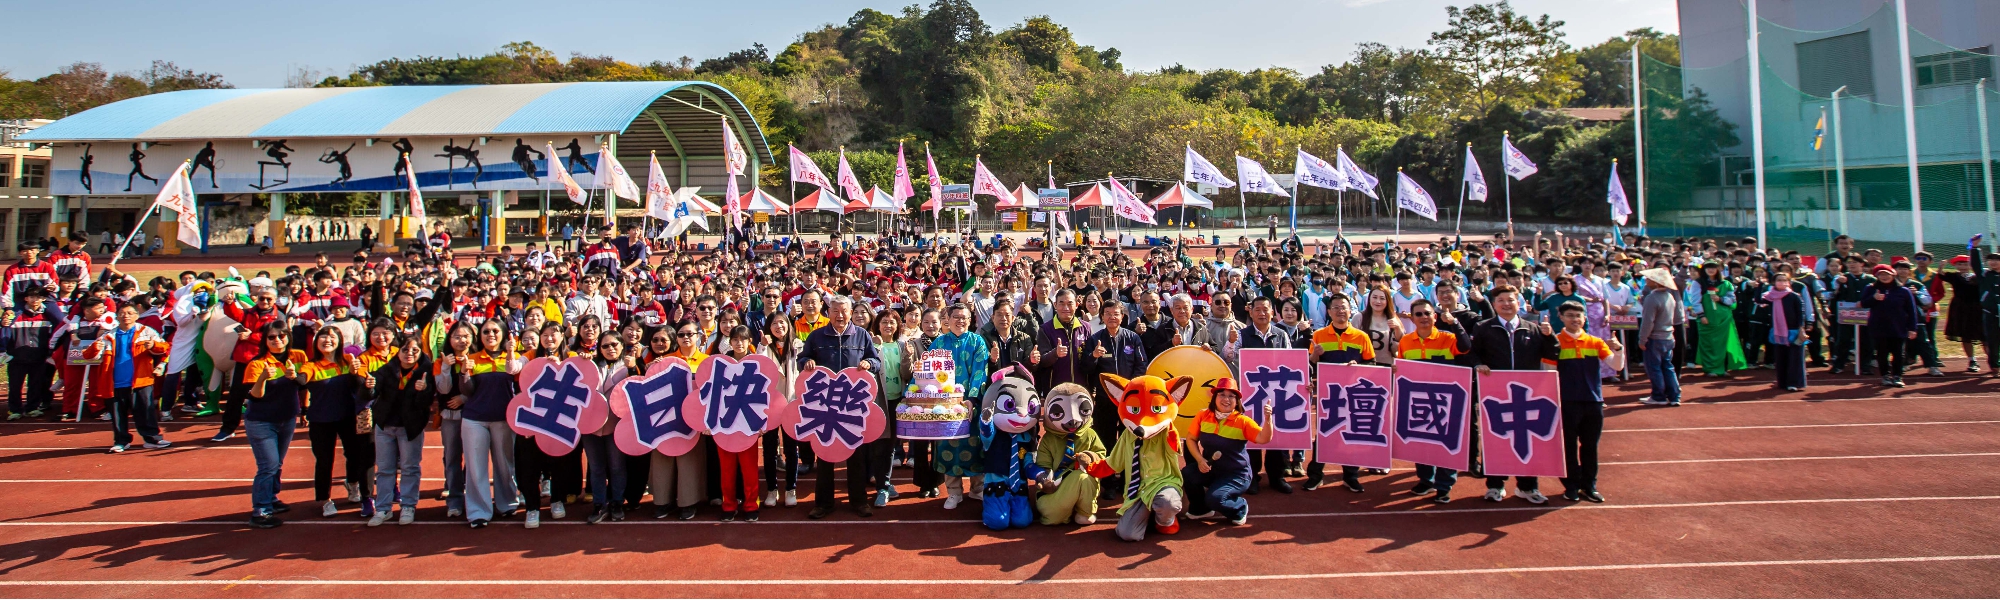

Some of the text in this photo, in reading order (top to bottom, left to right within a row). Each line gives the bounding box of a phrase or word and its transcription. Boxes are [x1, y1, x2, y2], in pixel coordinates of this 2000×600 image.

[1301, 172, 1338, 188] 七年六班
[1116, 203, 1149, 221] 八年一班
[1400, 197, 1431, 215] 七年四班
[921, 349, 952, 360] 64週年
[913, 360, 954, 372] 生日快樂
